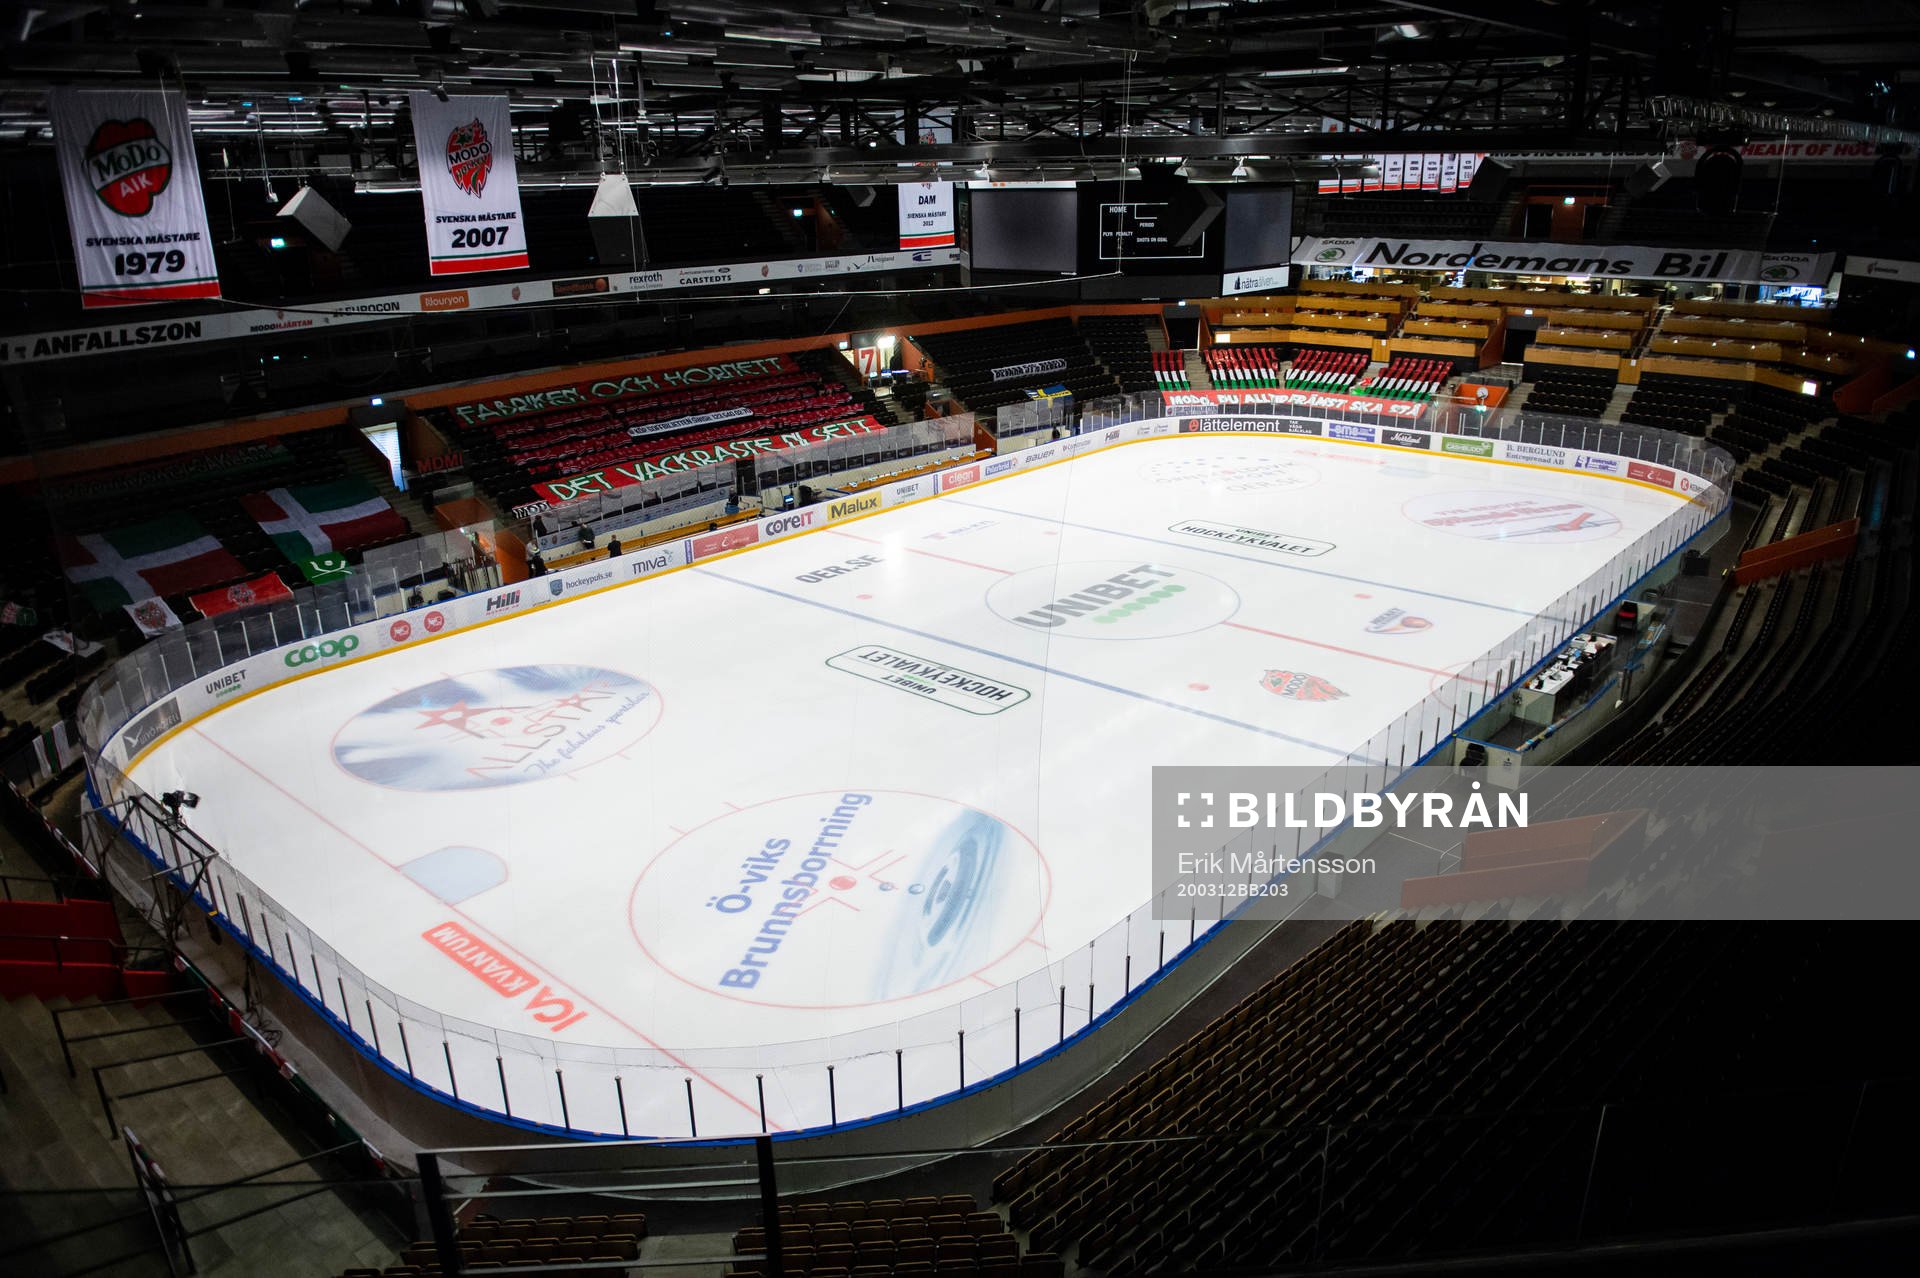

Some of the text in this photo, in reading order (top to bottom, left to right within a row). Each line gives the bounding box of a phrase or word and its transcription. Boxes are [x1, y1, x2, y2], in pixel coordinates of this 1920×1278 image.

[449, 143, 490, 165] MODO
[1740, 144, 1803, 156] HEART
[1804, 144, 1832, 156] OF
[94, 144, 161, 181] MoDo
[119, 172, 153, 197] AIK
[918, 195, 936, 205] DAM
[436, 212, 517, 223] SVENSKA MÄSTARE
[86, 232, 201, 247] SVENSKA MÄSTARE
[451, 226, 509, 249] 2007
[115, 249, 186, 276] 1979
[1365, 241, 1729, 278] Nordemans Bil
[629, 271, 663, 284] rexroth
[680, 275, 732, 286] CARSTEDTS
[33, 321, 201, 358] ANFALLSZON
[860, 348, 875, 376] 7
[590, 375, 661, 398] OCH
[663, 357, 785, 386] HORNETT
[1348, 400, 1383, 413] SKA
[1199, 418, 1280, 432] lättelement
[548, 471, 613, 501] DET
[616, 437, 781, 481] VACKRASTE
[812, 418, 875, 443] SETT
[1025, 449, 1056, 463] BAUER
[1506, 452, 1565, 466] Entreprenad AB
[1517, 444, 1566, 458] BERGLUND
[896, 483, 920, 496] UNIBET
[831, 496, 878, 519] Malux
[765, 511, 814, 537] coreIT
[1181, 524, 1317, 554] HOCKEYKVALET
[632, 555, 668, 575] miva
[565, 571, 613, 590] hockeypuls.se
[486, 589, 521, 612] Hilli
[1012, 562, 1177, 629] UNIBET
[284, 634, 360, 668] coop
[205, 670, 247, 694] UNIBET
[857, 648, 1015, 702] HOCKEYKVALET
[881, 673, 938, 696] UNIBET
[704, 836, 792, 914] Ö-viks
[718, 791, 873, 990] Brunnsborrning
[431, 925, 590, 1033] ICA KVANTUM
